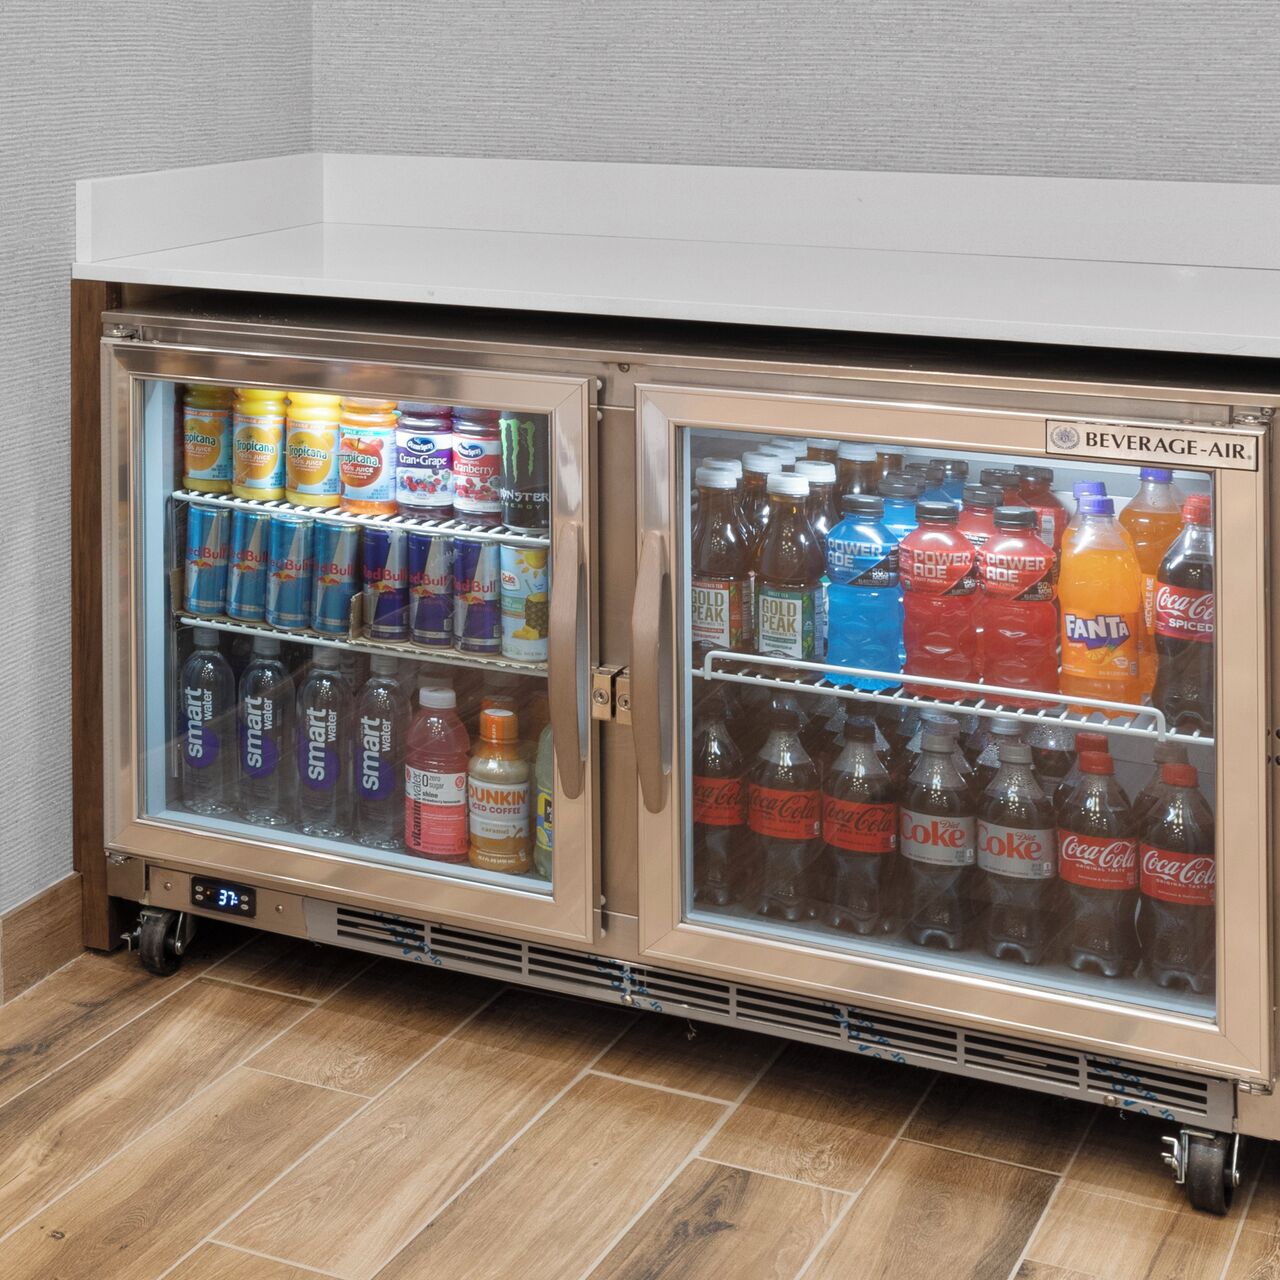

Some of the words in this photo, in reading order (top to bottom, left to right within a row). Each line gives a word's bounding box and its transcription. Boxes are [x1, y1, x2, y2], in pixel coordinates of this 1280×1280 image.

[236, 438, 275, 454] Tropicana
[288, 443, 328, 460] Tropicana
[1085, 431, 1246, 460] BEVERAGE-AIR
[453, 460, 495, 476] Cranberry
[828, 539, 883, 557] POWER
[986, 551, 1047, 572] POWER
[913, 565, 948, 580] ADE
[986, 568, 1019, 583] ADE
[761, 597, 797, 619] GOLD
[761, 615, 797, 634] PEAK
[1168, 617, 1214, 633] SPICED
[203, 688, 213, 721] water
[184, 685, 203, 760] smart
[263, 697, 273, 731] water
[244, 694, 263, 769] smart
[307, 706, 326, 782] smart
[421, 773, 429, 788] 0
[429, 774, 441, 782] zero
[429, 782, 445, 791] sugar
[422, 790, 439, 799] shine
[469, 783, 529, 807] DUNKIN'
[472, 801, 487, 813] ICED
[489, 806, 521, 815] COFFEE
[481, 826, 510, 836] caramel
[900, 811, 965, 849] Coke
[939, 820, 961, 830] Diet
[977, 822, 1042, 861] Coke
[1014, 830, 1037, 842] Diet
[1061, 835, 1137, 869] Coca-Cola
[1142, 849, 1217, 886] Coca-Cola
